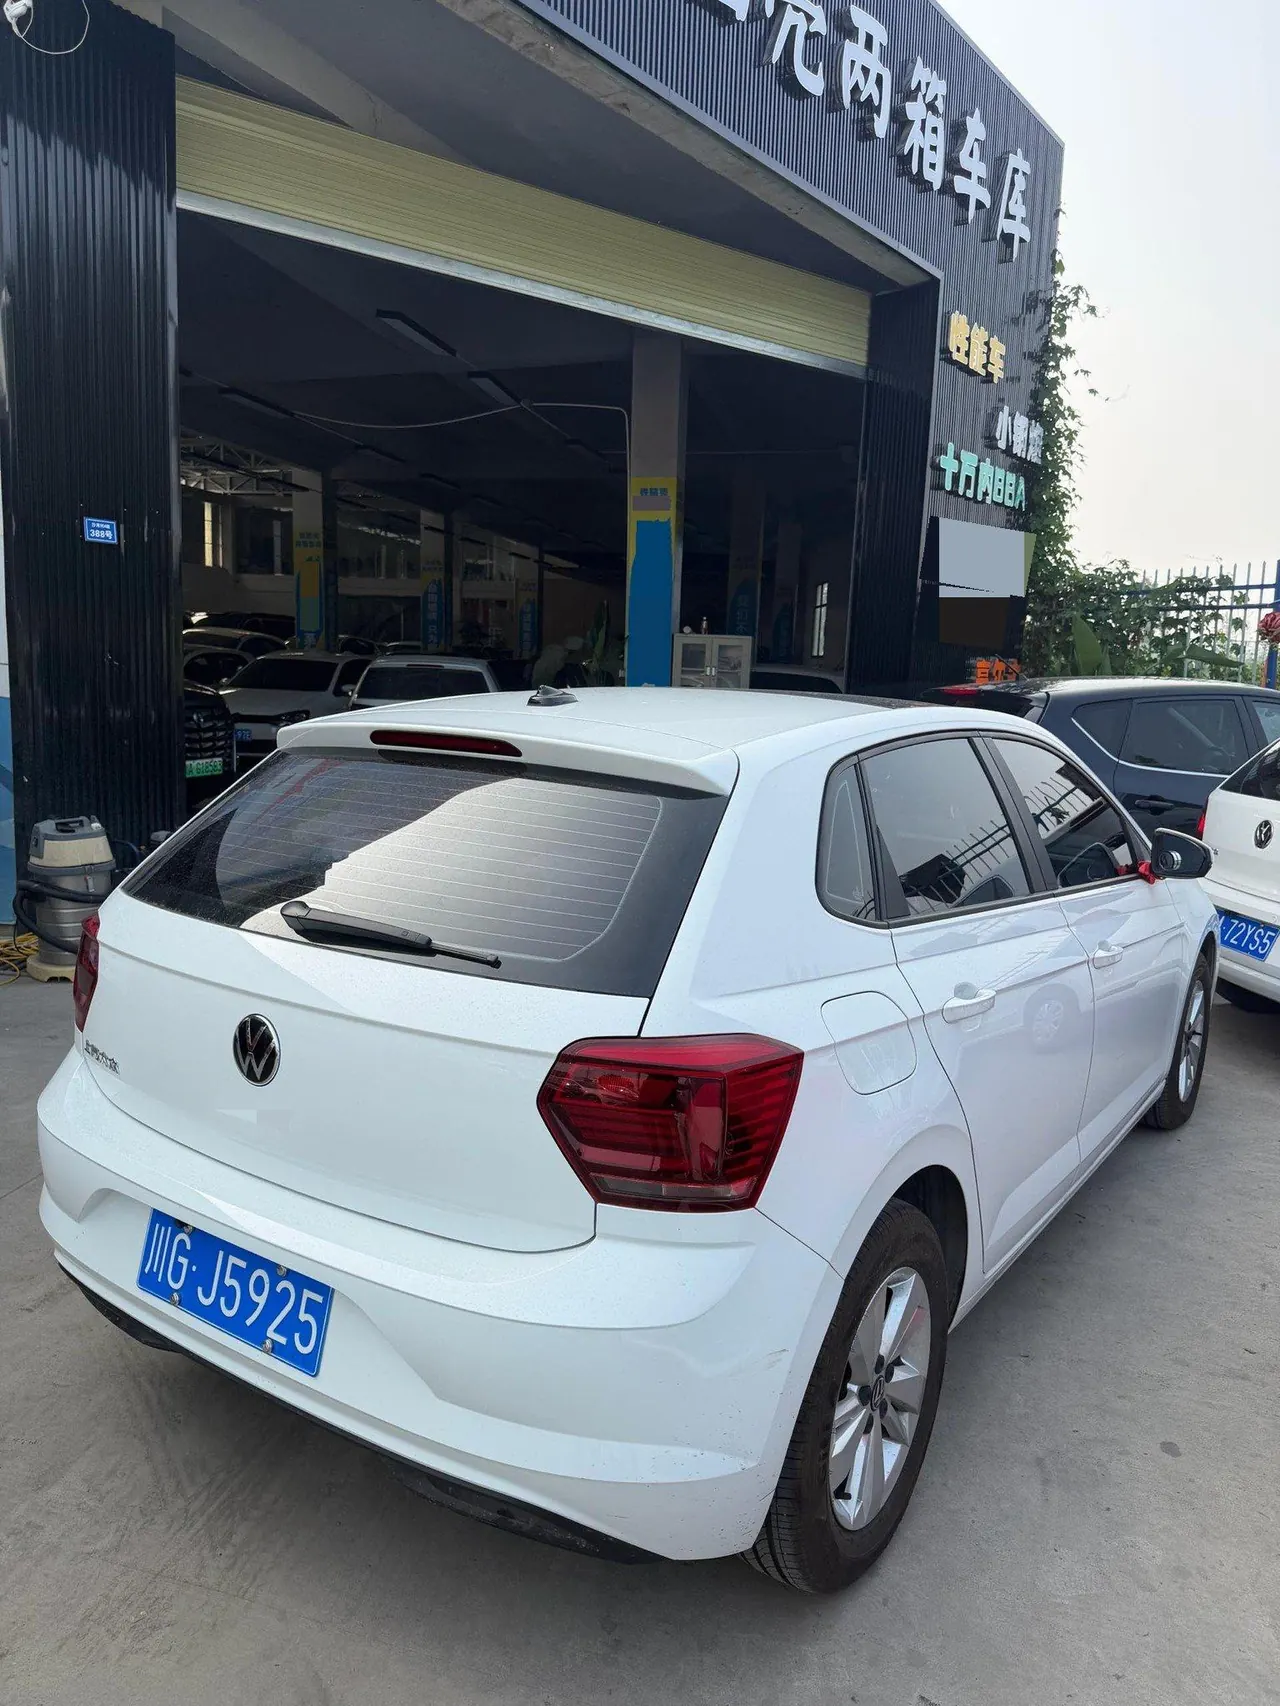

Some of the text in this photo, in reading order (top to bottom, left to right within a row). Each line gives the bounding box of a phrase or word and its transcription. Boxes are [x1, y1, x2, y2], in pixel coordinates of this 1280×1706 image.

[949, 310, 1006, 384] 性能车
[90, 529, 113, 541] 388号
[144, 1222, 325, 1355] 川G·J5925
